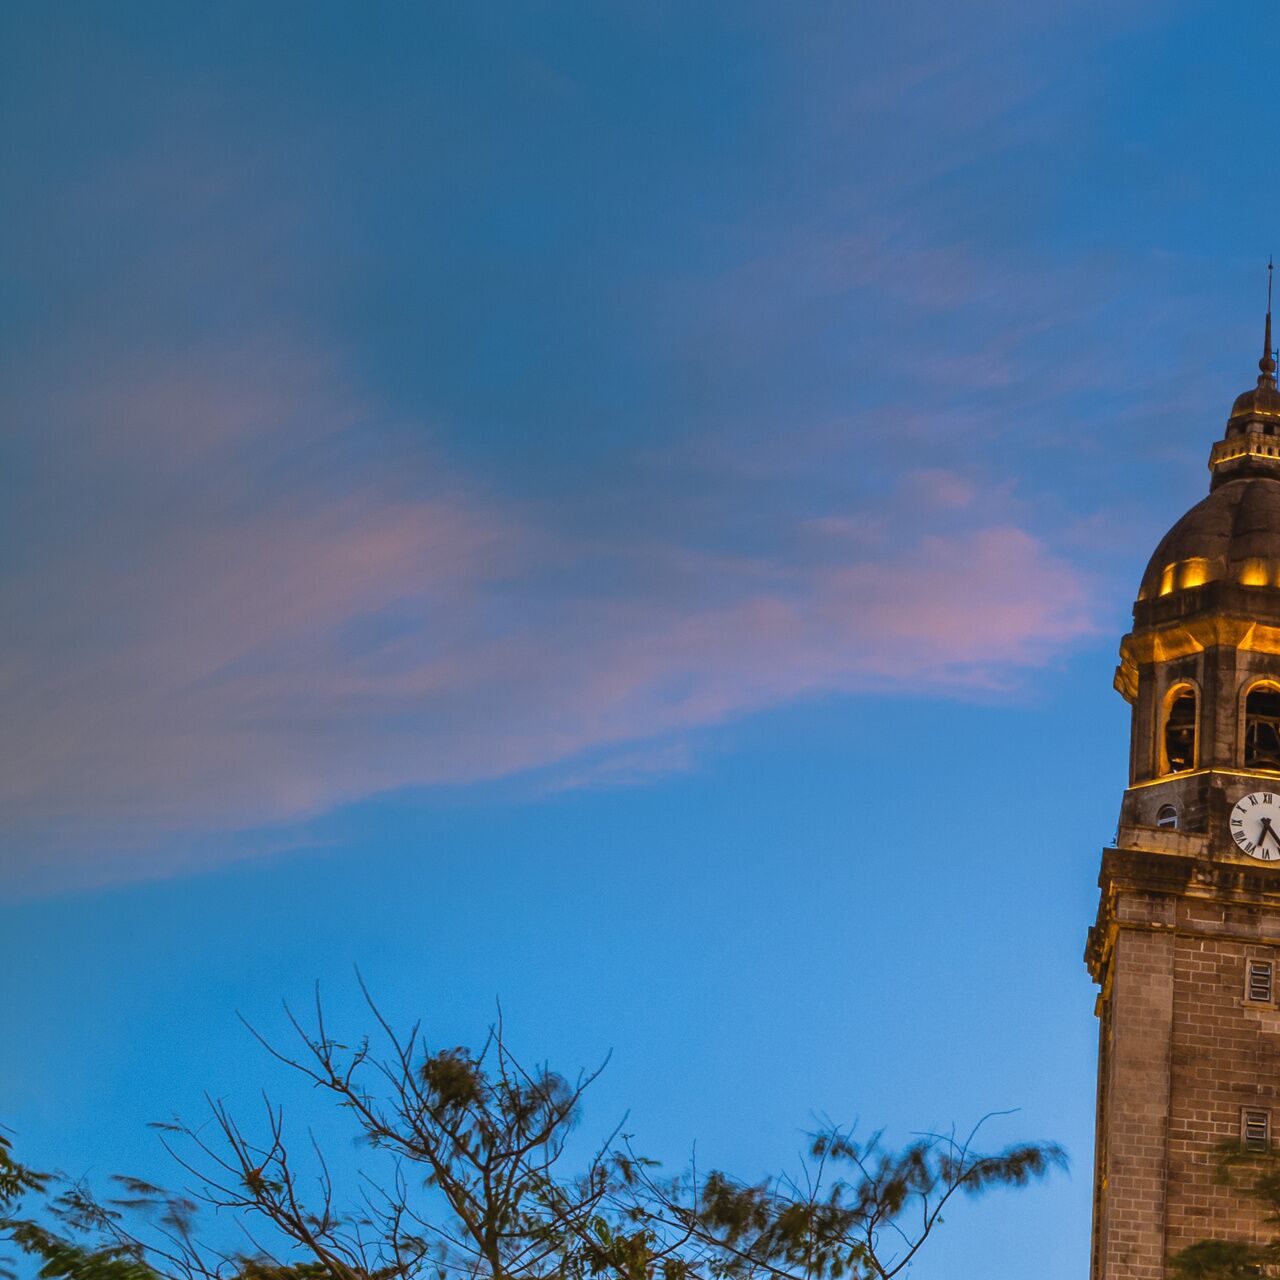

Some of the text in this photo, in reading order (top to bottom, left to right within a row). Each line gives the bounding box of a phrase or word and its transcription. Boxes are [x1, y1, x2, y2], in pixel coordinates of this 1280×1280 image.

[1248, 794, 1258, 806] XI
[1263, 793, 1272, 804] XII
[1236, 804, 1247, 814] X
[1233, 831, 1247, 844] VIII
[1244, 842, 1257, 855] VII
[1262, 848, 1270, 859] VI
